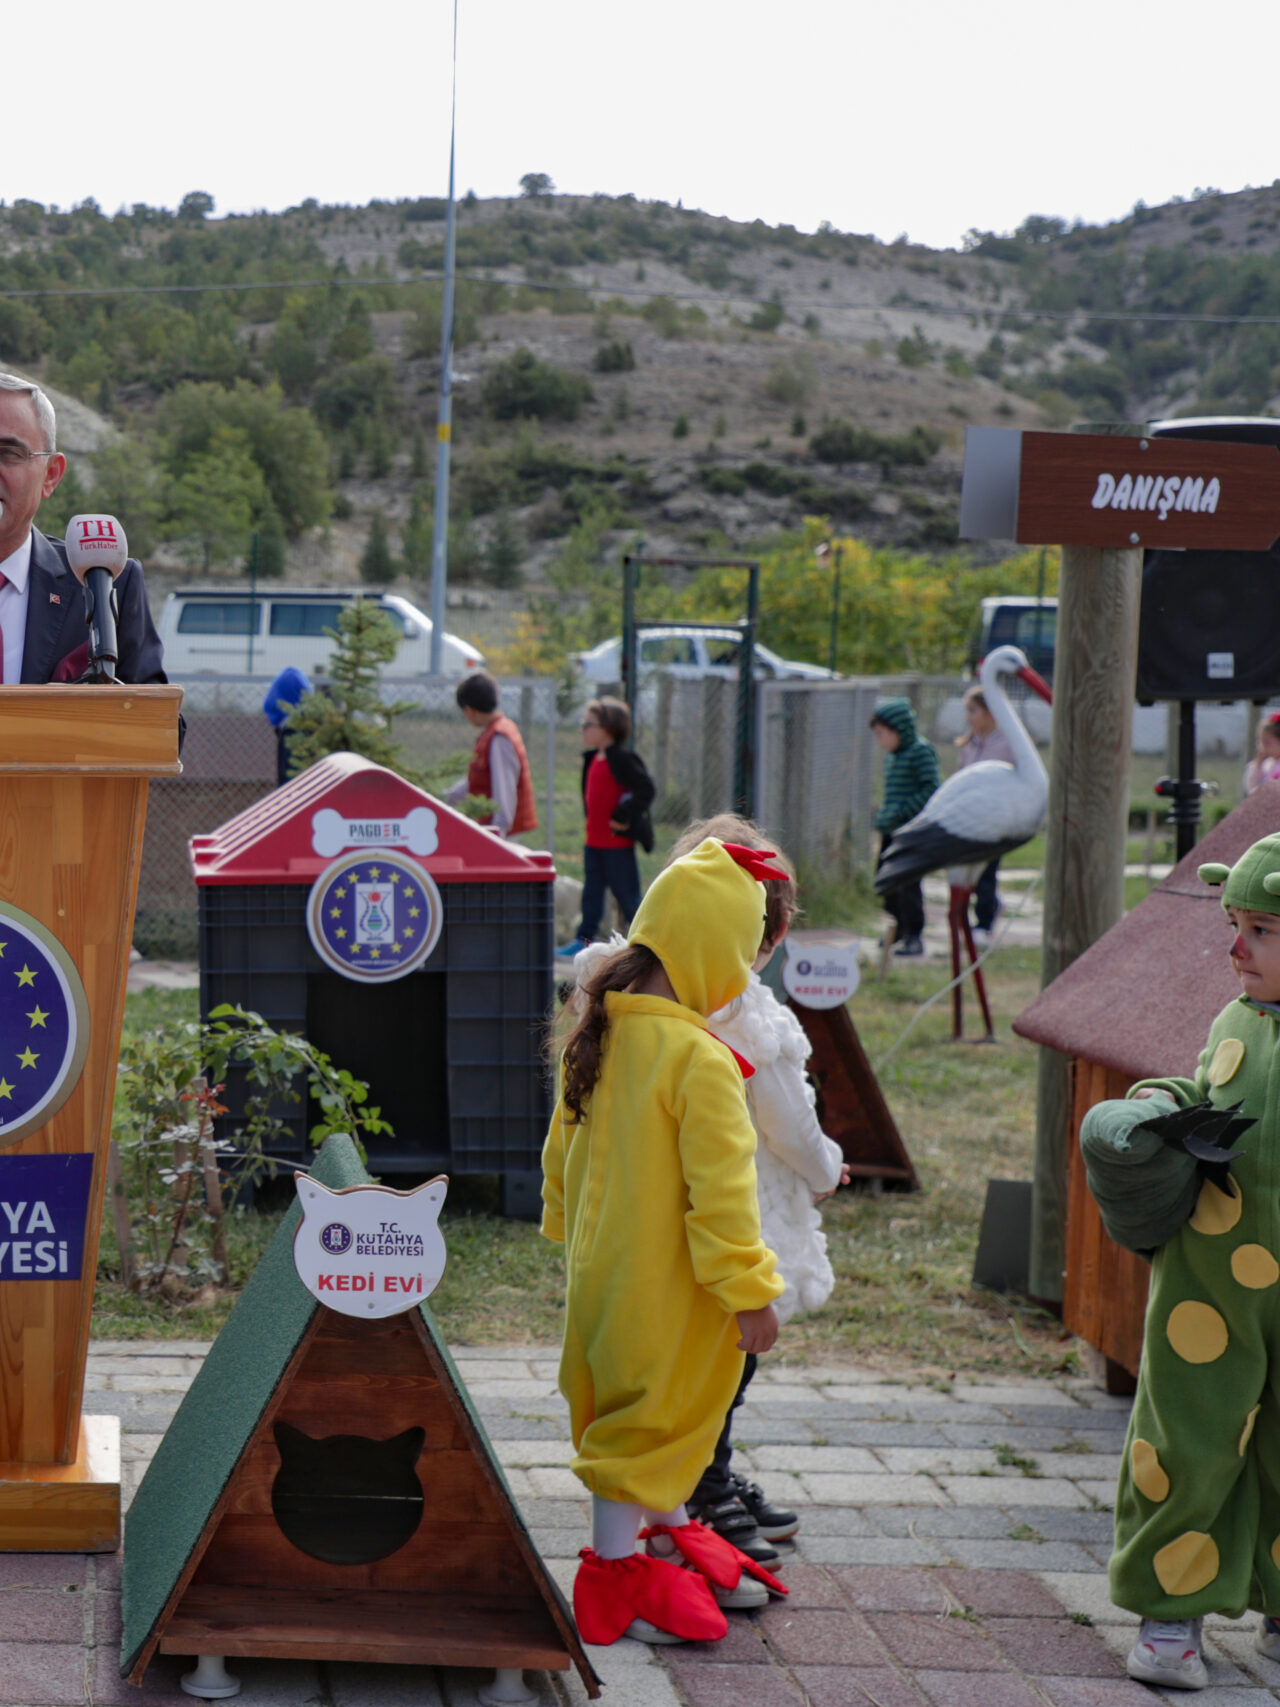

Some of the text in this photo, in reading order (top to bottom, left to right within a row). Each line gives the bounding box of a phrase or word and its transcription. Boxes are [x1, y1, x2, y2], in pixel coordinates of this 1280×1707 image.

[1091, 473, 1220, 520] DANIŞMA
[76, 519, 117, 537] TH
[349, 824, 401, 837] PAGDER
[379, 1222, 402, 1233] T.C.
[356, 1233, 423, 1245] KÜTAHYA
[356, 1245, 424, 1256] BELEDİYESİ
[317, 1272, 423, 1293] KEDİ EVİ
